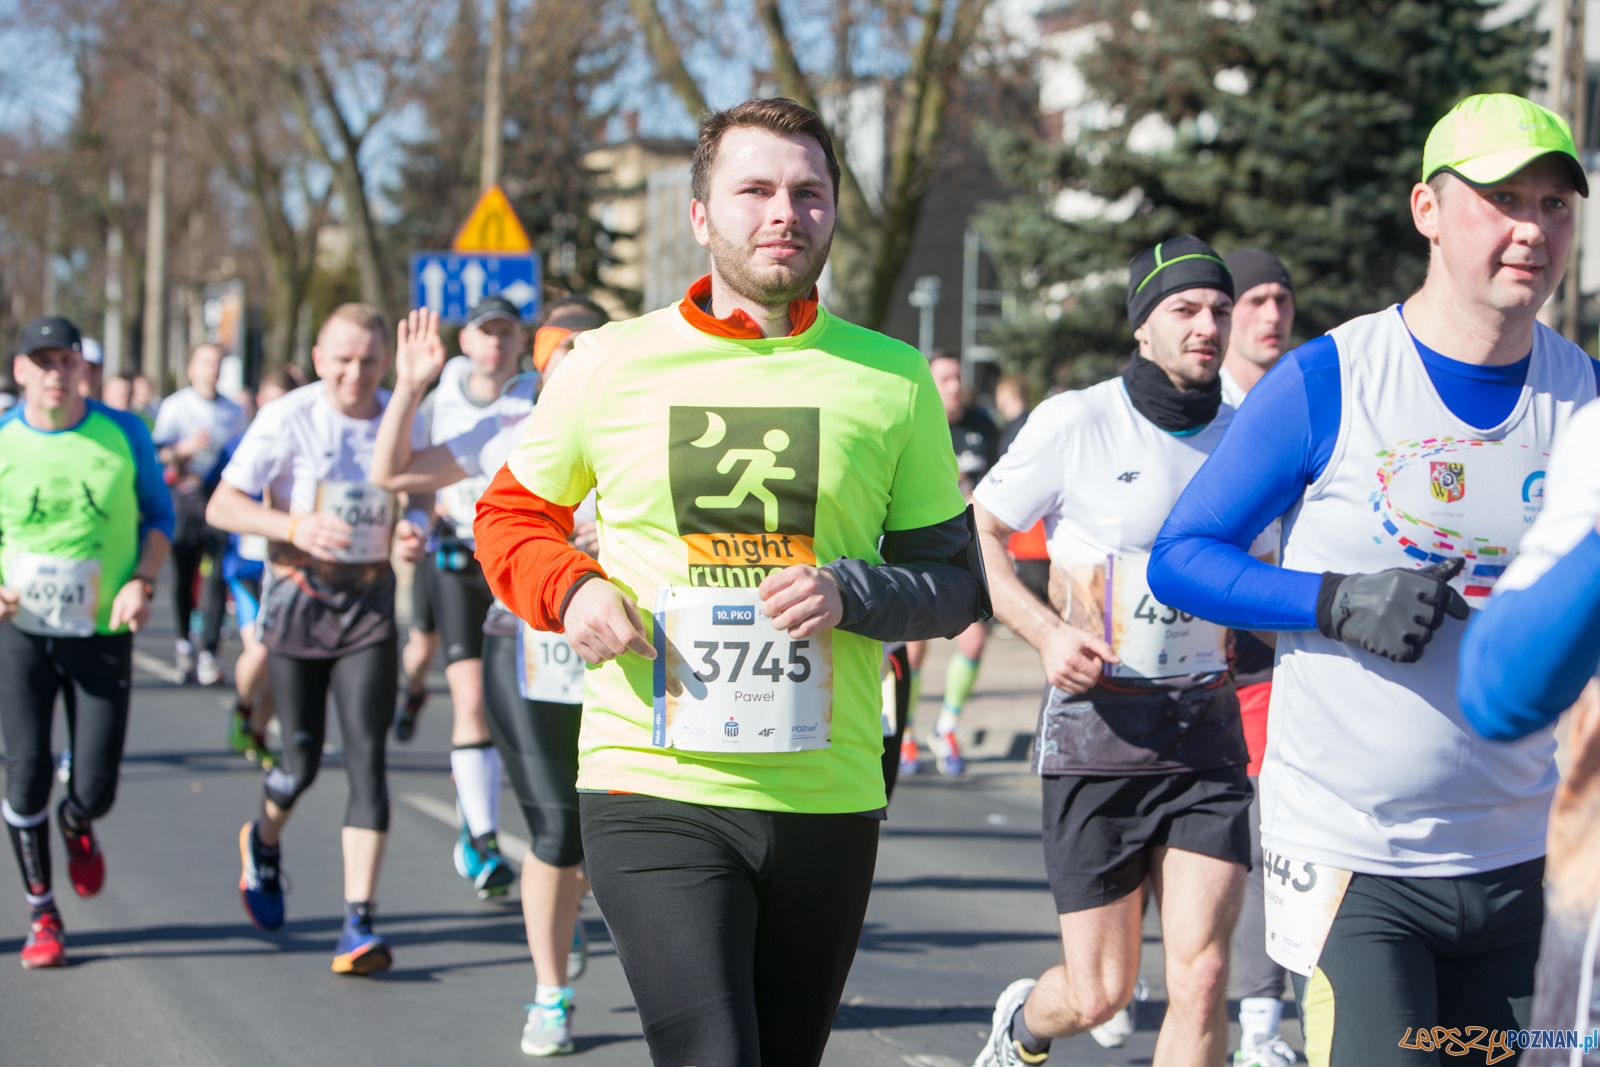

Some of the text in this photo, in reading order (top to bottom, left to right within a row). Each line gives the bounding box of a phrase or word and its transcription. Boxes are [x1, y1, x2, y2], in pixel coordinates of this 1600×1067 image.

[1117, 471, 1141, 483] 4F
[711, 534, 795, 564] night
[27, 583, 85, 602] 4941
[716, 611, 730, 620] 10.
[730, 611, 752, 620] PKO
[1165, 629, 1190, 640] Daniel
[692, 640, 812, 683] 3745
[734, 690, 775, 702] Paweł
[758, 727, 776, 737] 4F
